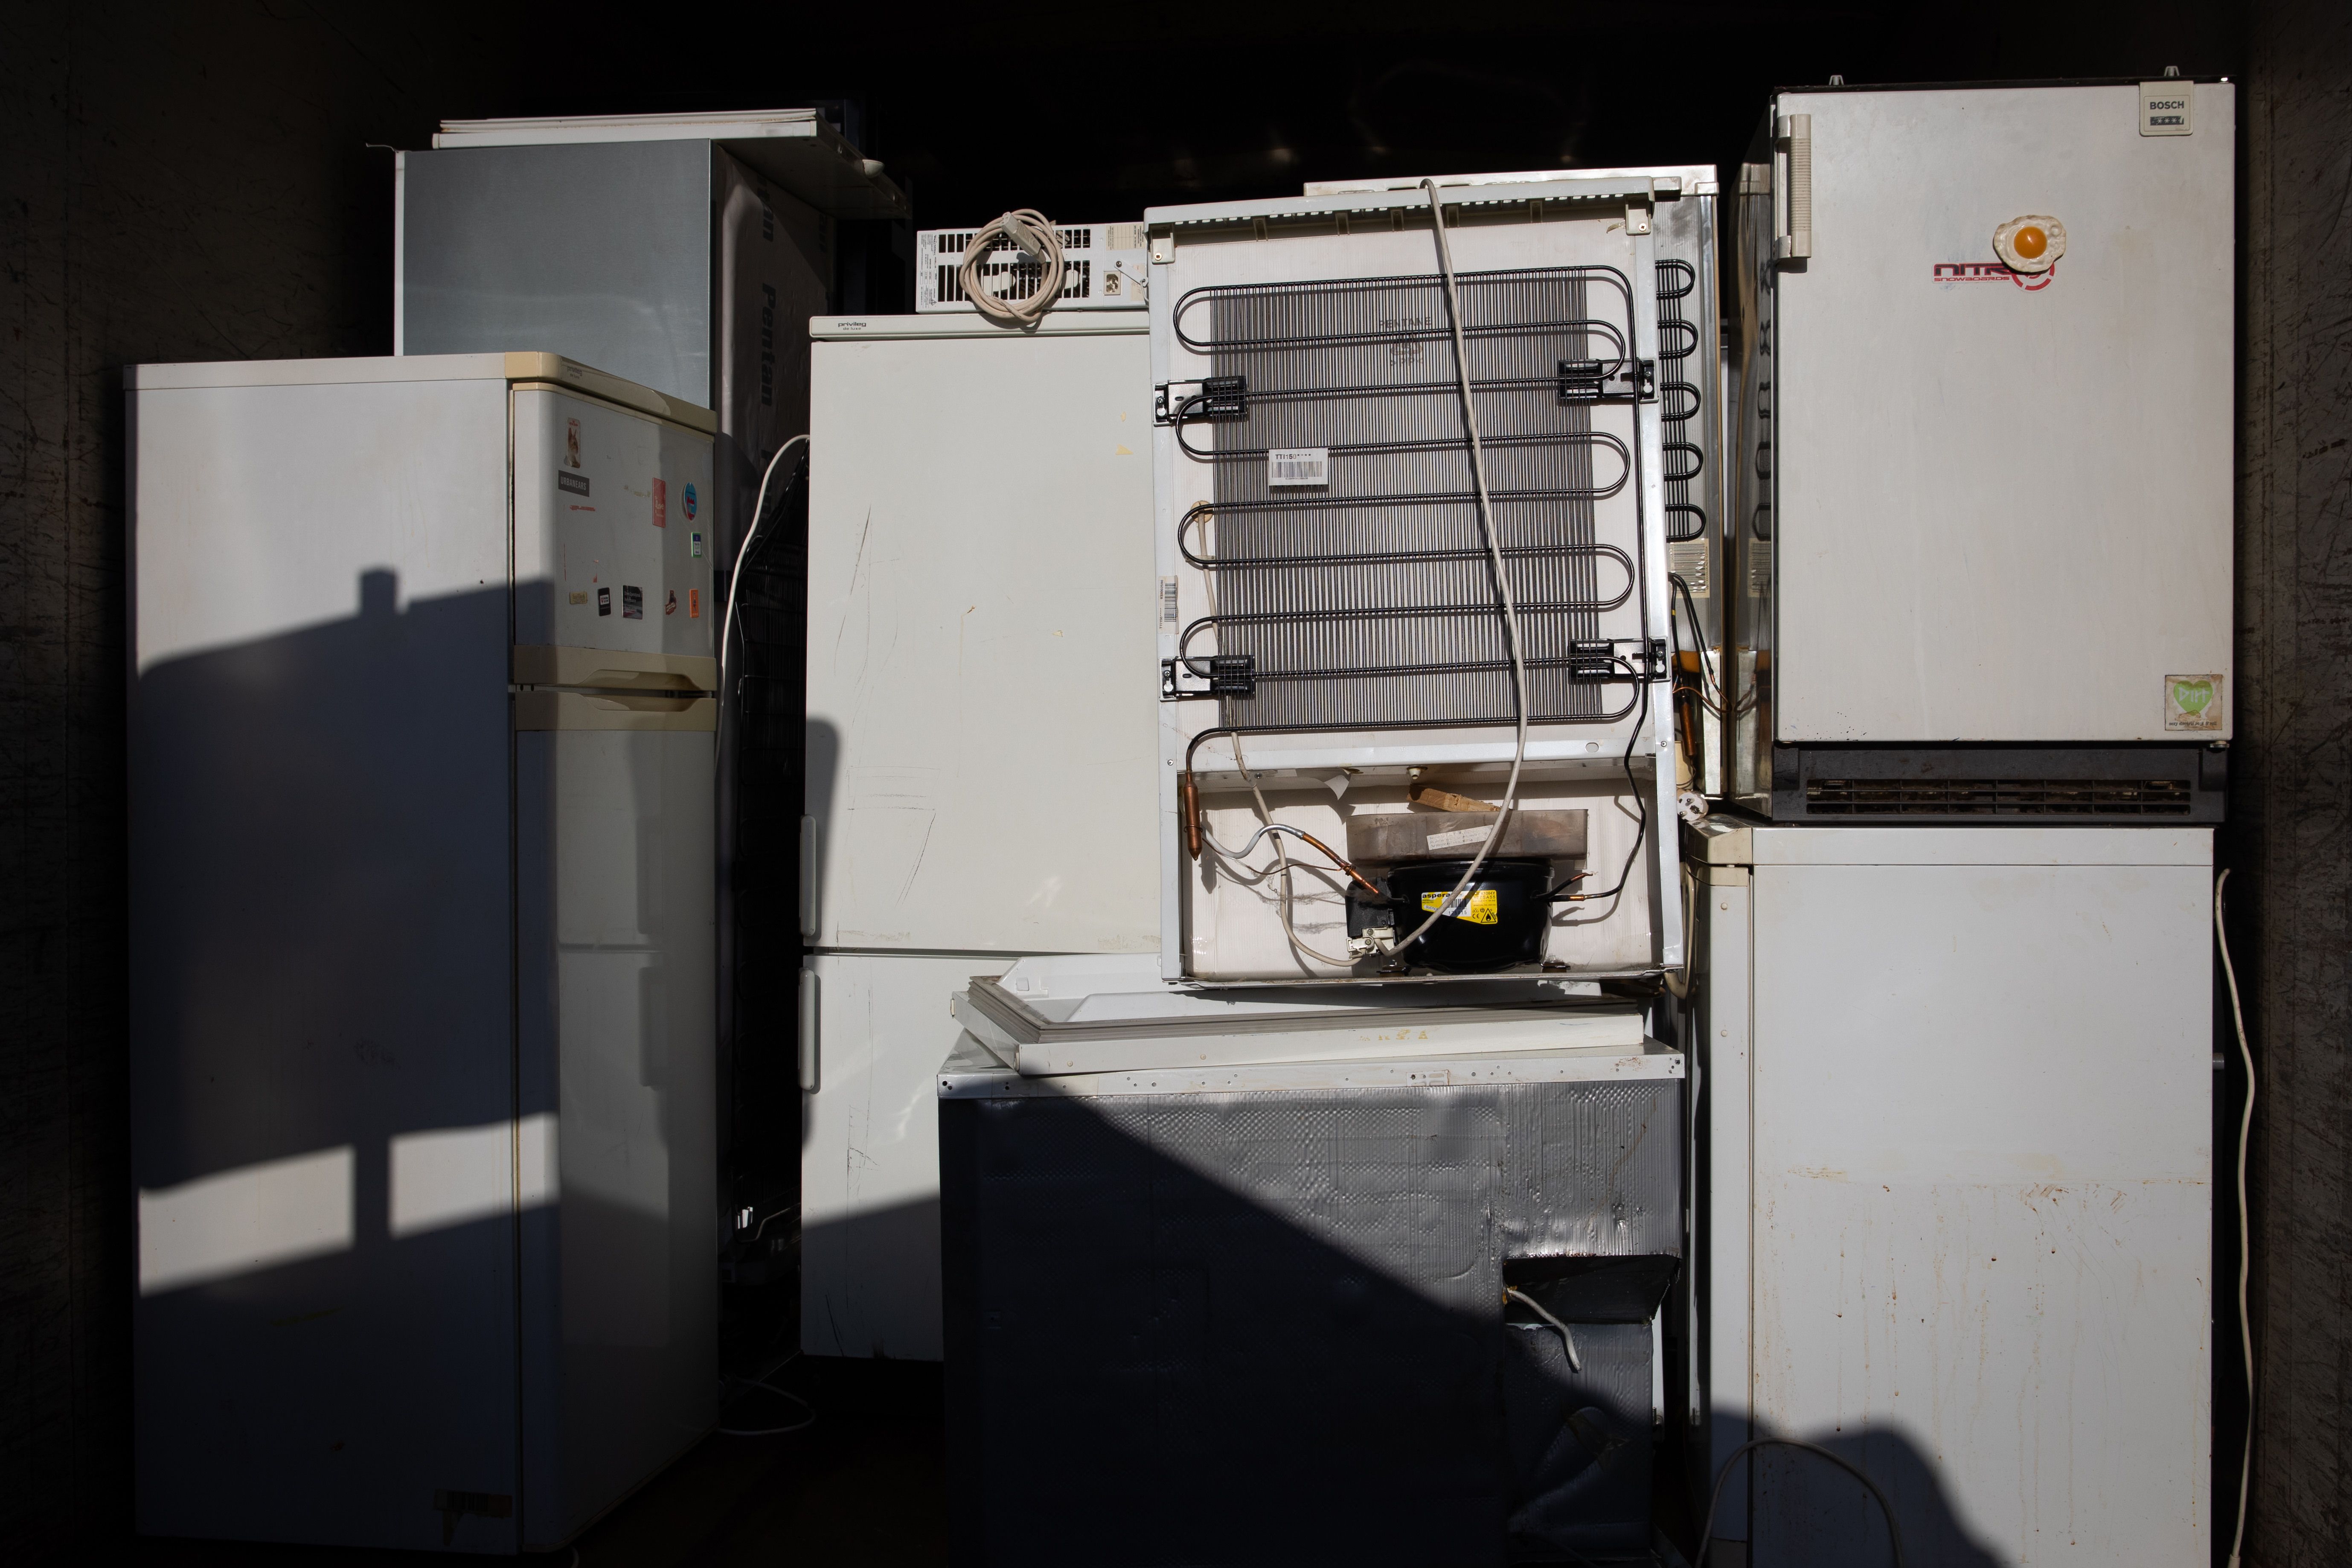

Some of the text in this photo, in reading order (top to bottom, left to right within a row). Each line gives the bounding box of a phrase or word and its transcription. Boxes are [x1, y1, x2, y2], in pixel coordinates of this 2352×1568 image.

[2150, 101, 2184, 110] BOSCH
[1379, 317, 1431, 328] PENTANE
[761, 282, 777, 407] Pentan
[561, 476, 586, 490] URBANEARS
